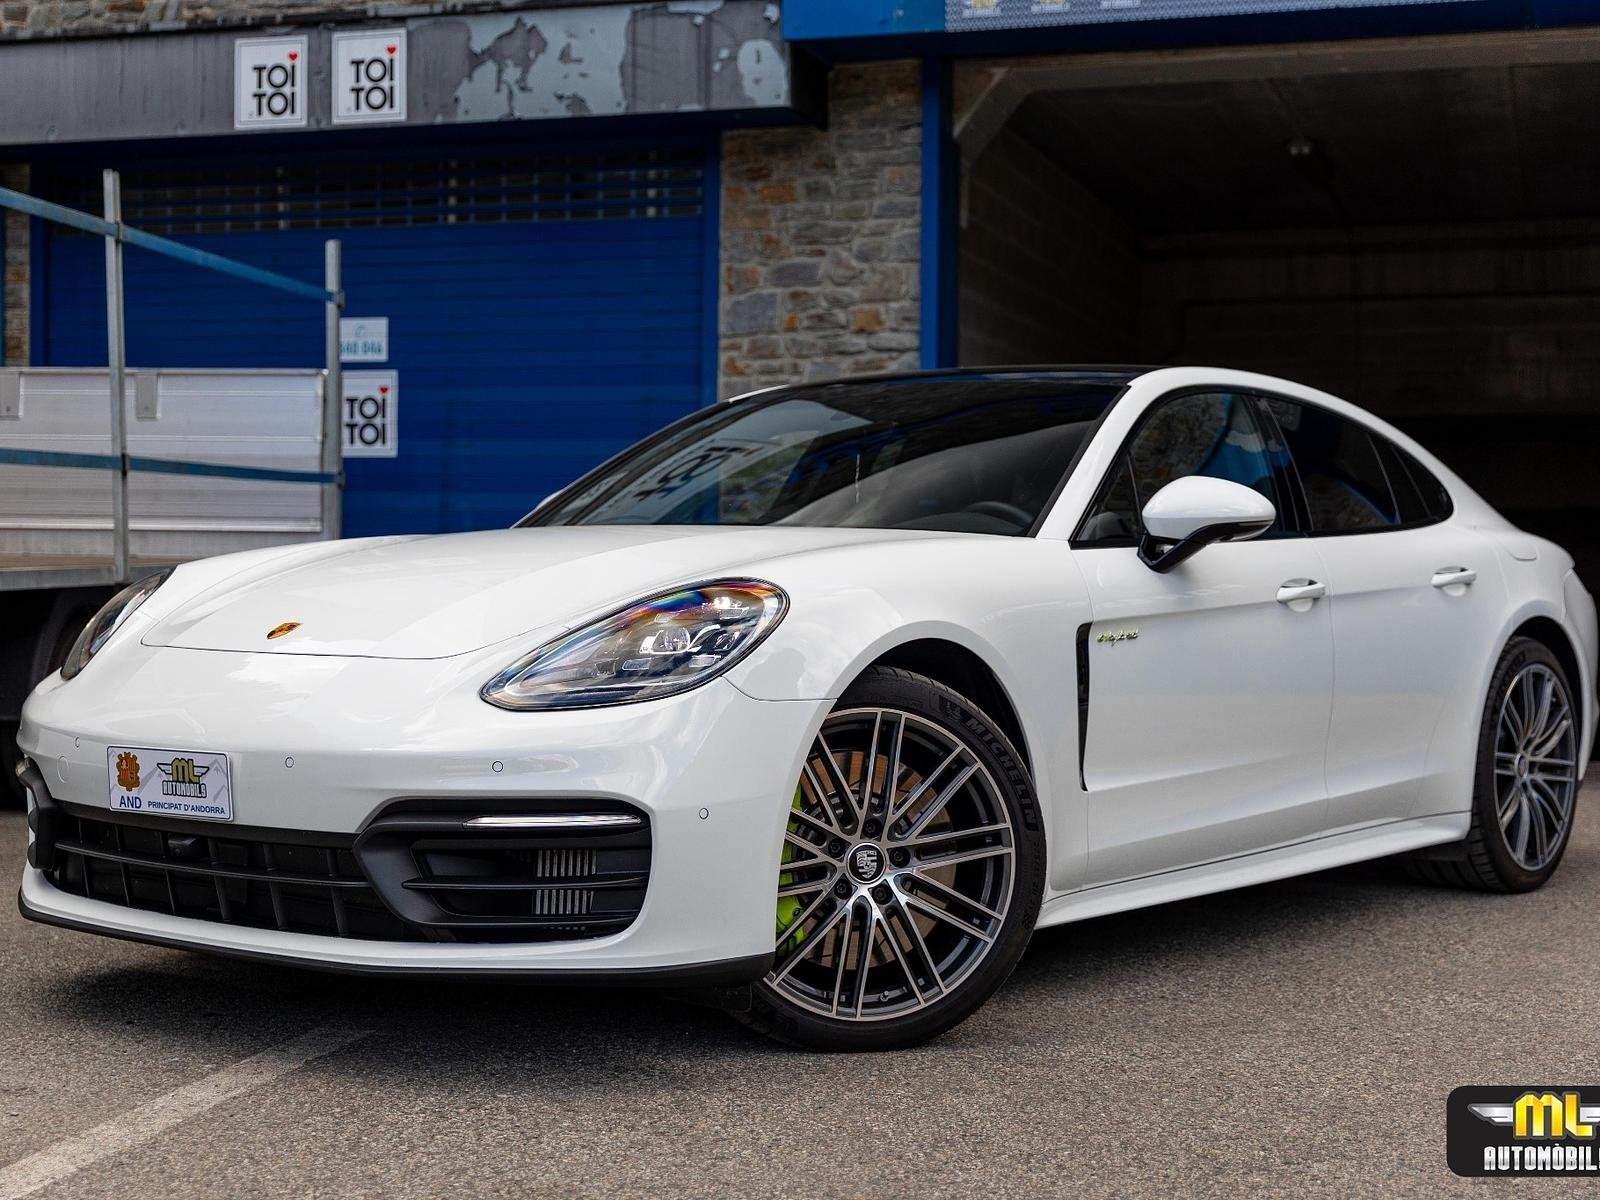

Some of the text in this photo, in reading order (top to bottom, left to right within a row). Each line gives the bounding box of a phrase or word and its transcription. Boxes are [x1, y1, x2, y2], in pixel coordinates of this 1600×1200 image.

[253, 91, 295, 116] TOI
[351, 85, 394, 111] TOI
[345, 423, 386, 445] TOI
[171, 757, 201, 784] ML
[965, 717, 1040, 832] MICHELIN
[119, 795, 142, 809] AND
[147, 800, 226, 815] PRINCIPAT D'ANDORRA
